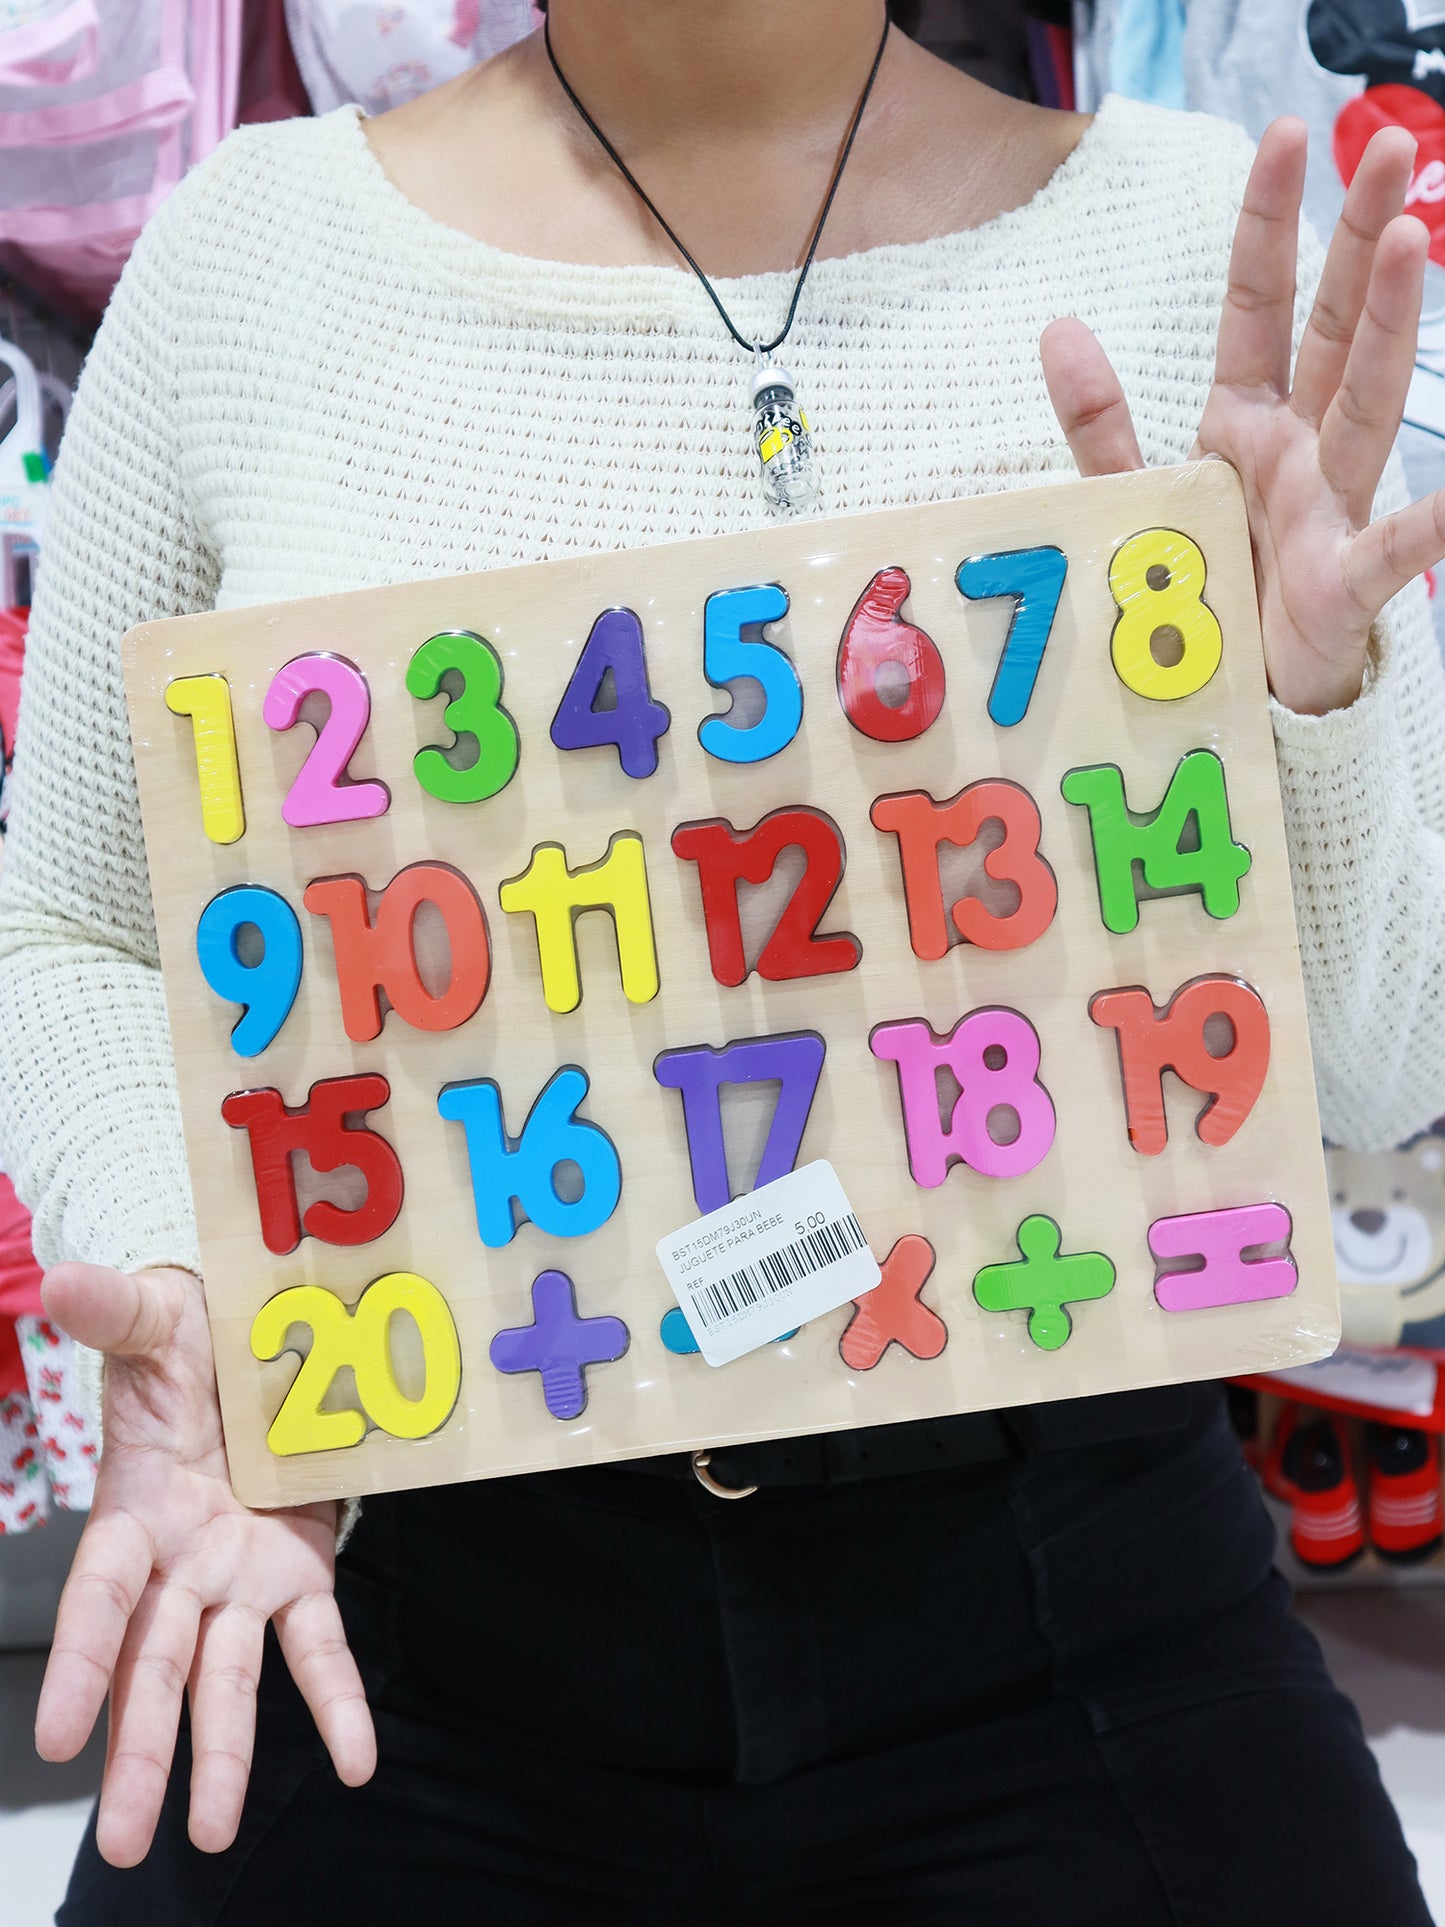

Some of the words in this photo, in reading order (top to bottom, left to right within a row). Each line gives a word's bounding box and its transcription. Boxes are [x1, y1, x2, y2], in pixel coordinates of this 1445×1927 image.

[165, 673, 246, 845] 1
[263, 652, 390, 828] 2
[405, 632, 519, 804] 3
[550, 606, 670, 779] 4
[698, 582, 803, 764] 5
[837, 566, 946, 742] 6
[955, 545, 1068, 728] 7
[1108, 527, 1223, 700] 8
[196, 884, 303, 1058] 9
[303, 861, 492, 1042] 10
[499, 829, 661, 1014] 11
[671, 805, 862, 987] 12
[870, 778, 1057, 961] 13
[1061, 748, 1252, 935] 14
[221, 1072, 404, 1256] 15
[437, 1065, 622, 1249] 16
[653, 1029, 827, 1214] 17
[869, 1005, 1056, 1188] 18
[1088, 973, 1272, 1156] 19
[672, 1209, 762, 1261] BST15DM79J30UN
[679, 1242, 727, 1274] JUGUETE
[726, 1228, 756, 1249] PARA
[756, 1213, 785, 1234] BEBE
[250, 1271, 462, 1457] 20
